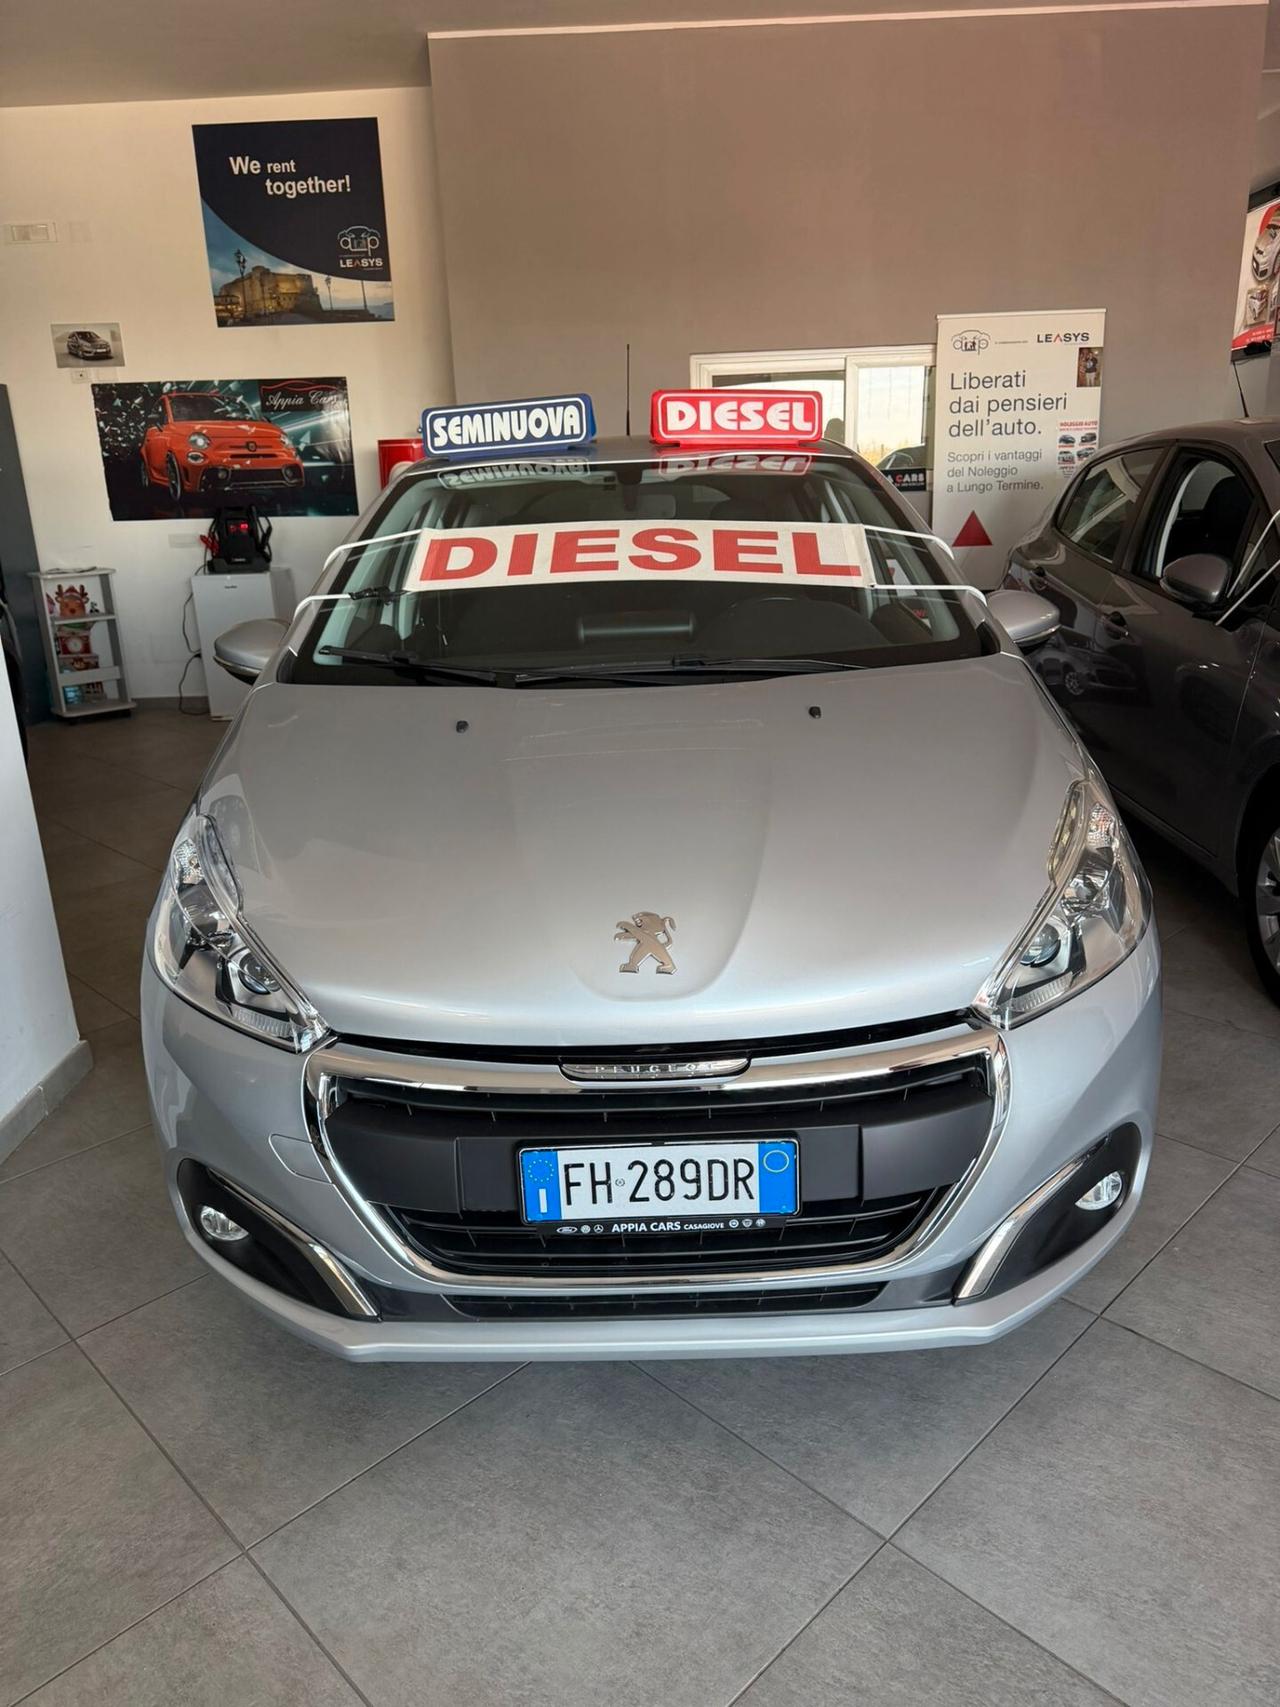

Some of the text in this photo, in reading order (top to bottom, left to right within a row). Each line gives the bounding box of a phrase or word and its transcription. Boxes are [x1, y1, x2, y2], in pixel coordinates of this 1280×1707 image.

[229, 155, 296, 175] We rent
[265, 175, 351, 199] together!
[339, 257, 383, 268] LEASYS
[1037, 332, 1090, 344] LEASYS
[951, 370, 1026, 390] Liberati
[266, 390, 337, 410] Appia Cars
[949, 392, 1067, 417] dai pensieri
[433, 405, 580, 447] SEMINUOVA
[666, 400, 813, 433] DIESEL
[948, 418, 1042, 438] dell'auto.
[948, 449, 1042, 465] Scopri i vantaggi
[947, 465, 1018, 480] del Noleggio
[947, 480, 1043, 495] a Lungo Termine.
[420, 527, 861, 580] DIESEL
[612, 1221, 724, 1233] APPIA CARS CASAGIOVE
